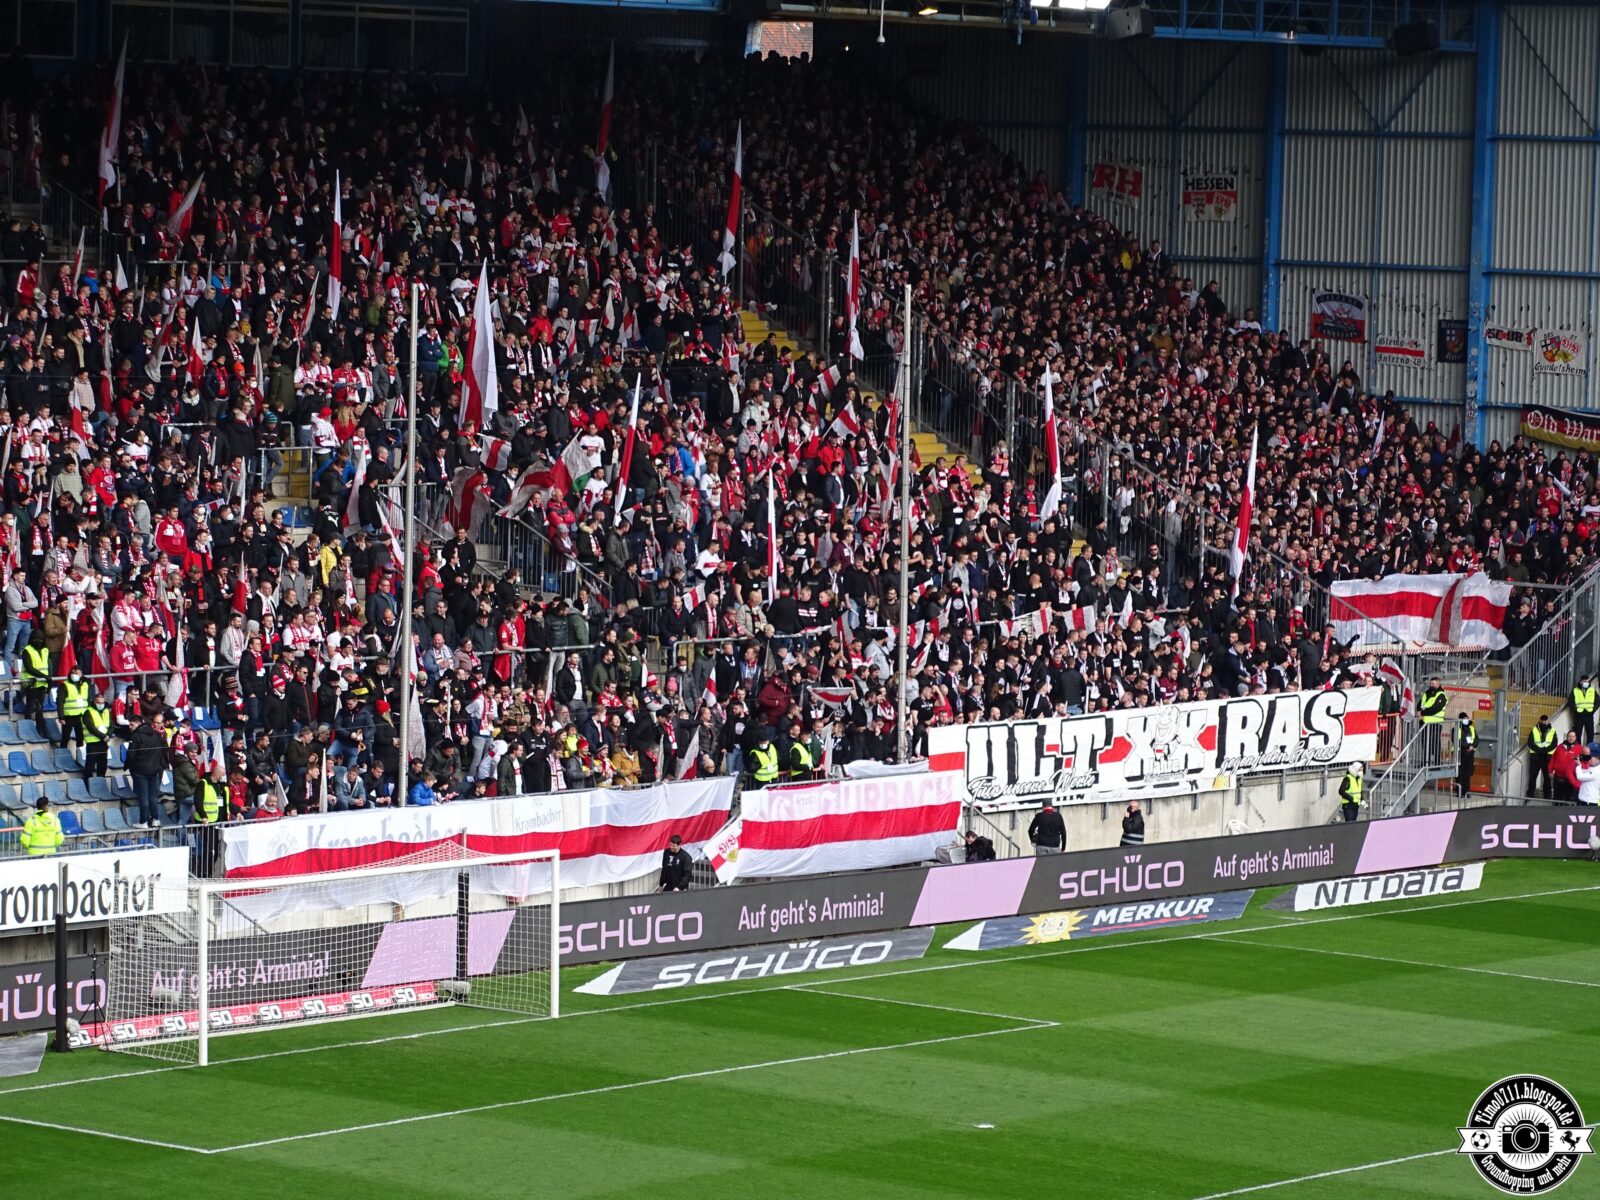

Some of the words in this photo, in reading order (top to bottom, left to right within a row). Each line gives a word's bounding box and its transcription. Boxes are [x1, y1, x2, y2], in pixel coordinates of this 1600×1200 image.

[1185, 177, 1234, 190] HESSEN
[1527, 409, 1558, 434] Old
[515, 809, 563, 833] Krombacher
[1059, 854, 1185, 900] SCHÜCO
[1213, 855, 1238, 879] Auf
[1240, 851, 1279, 881] geht's
[1281, 843, 1334, 870] Arminia!
[559, 904, 703, 955] SCHÜCO
[738, 905, 769, 932] Auf
[770, 900, 817, 934] geht's
[820, 891, 885, 921] Arminia!
[1092, 897, 1214, 927] MERKUR
[253, 950, 330, 986] Arminia!
[652, 940, 893, 989] SCHÜCO
